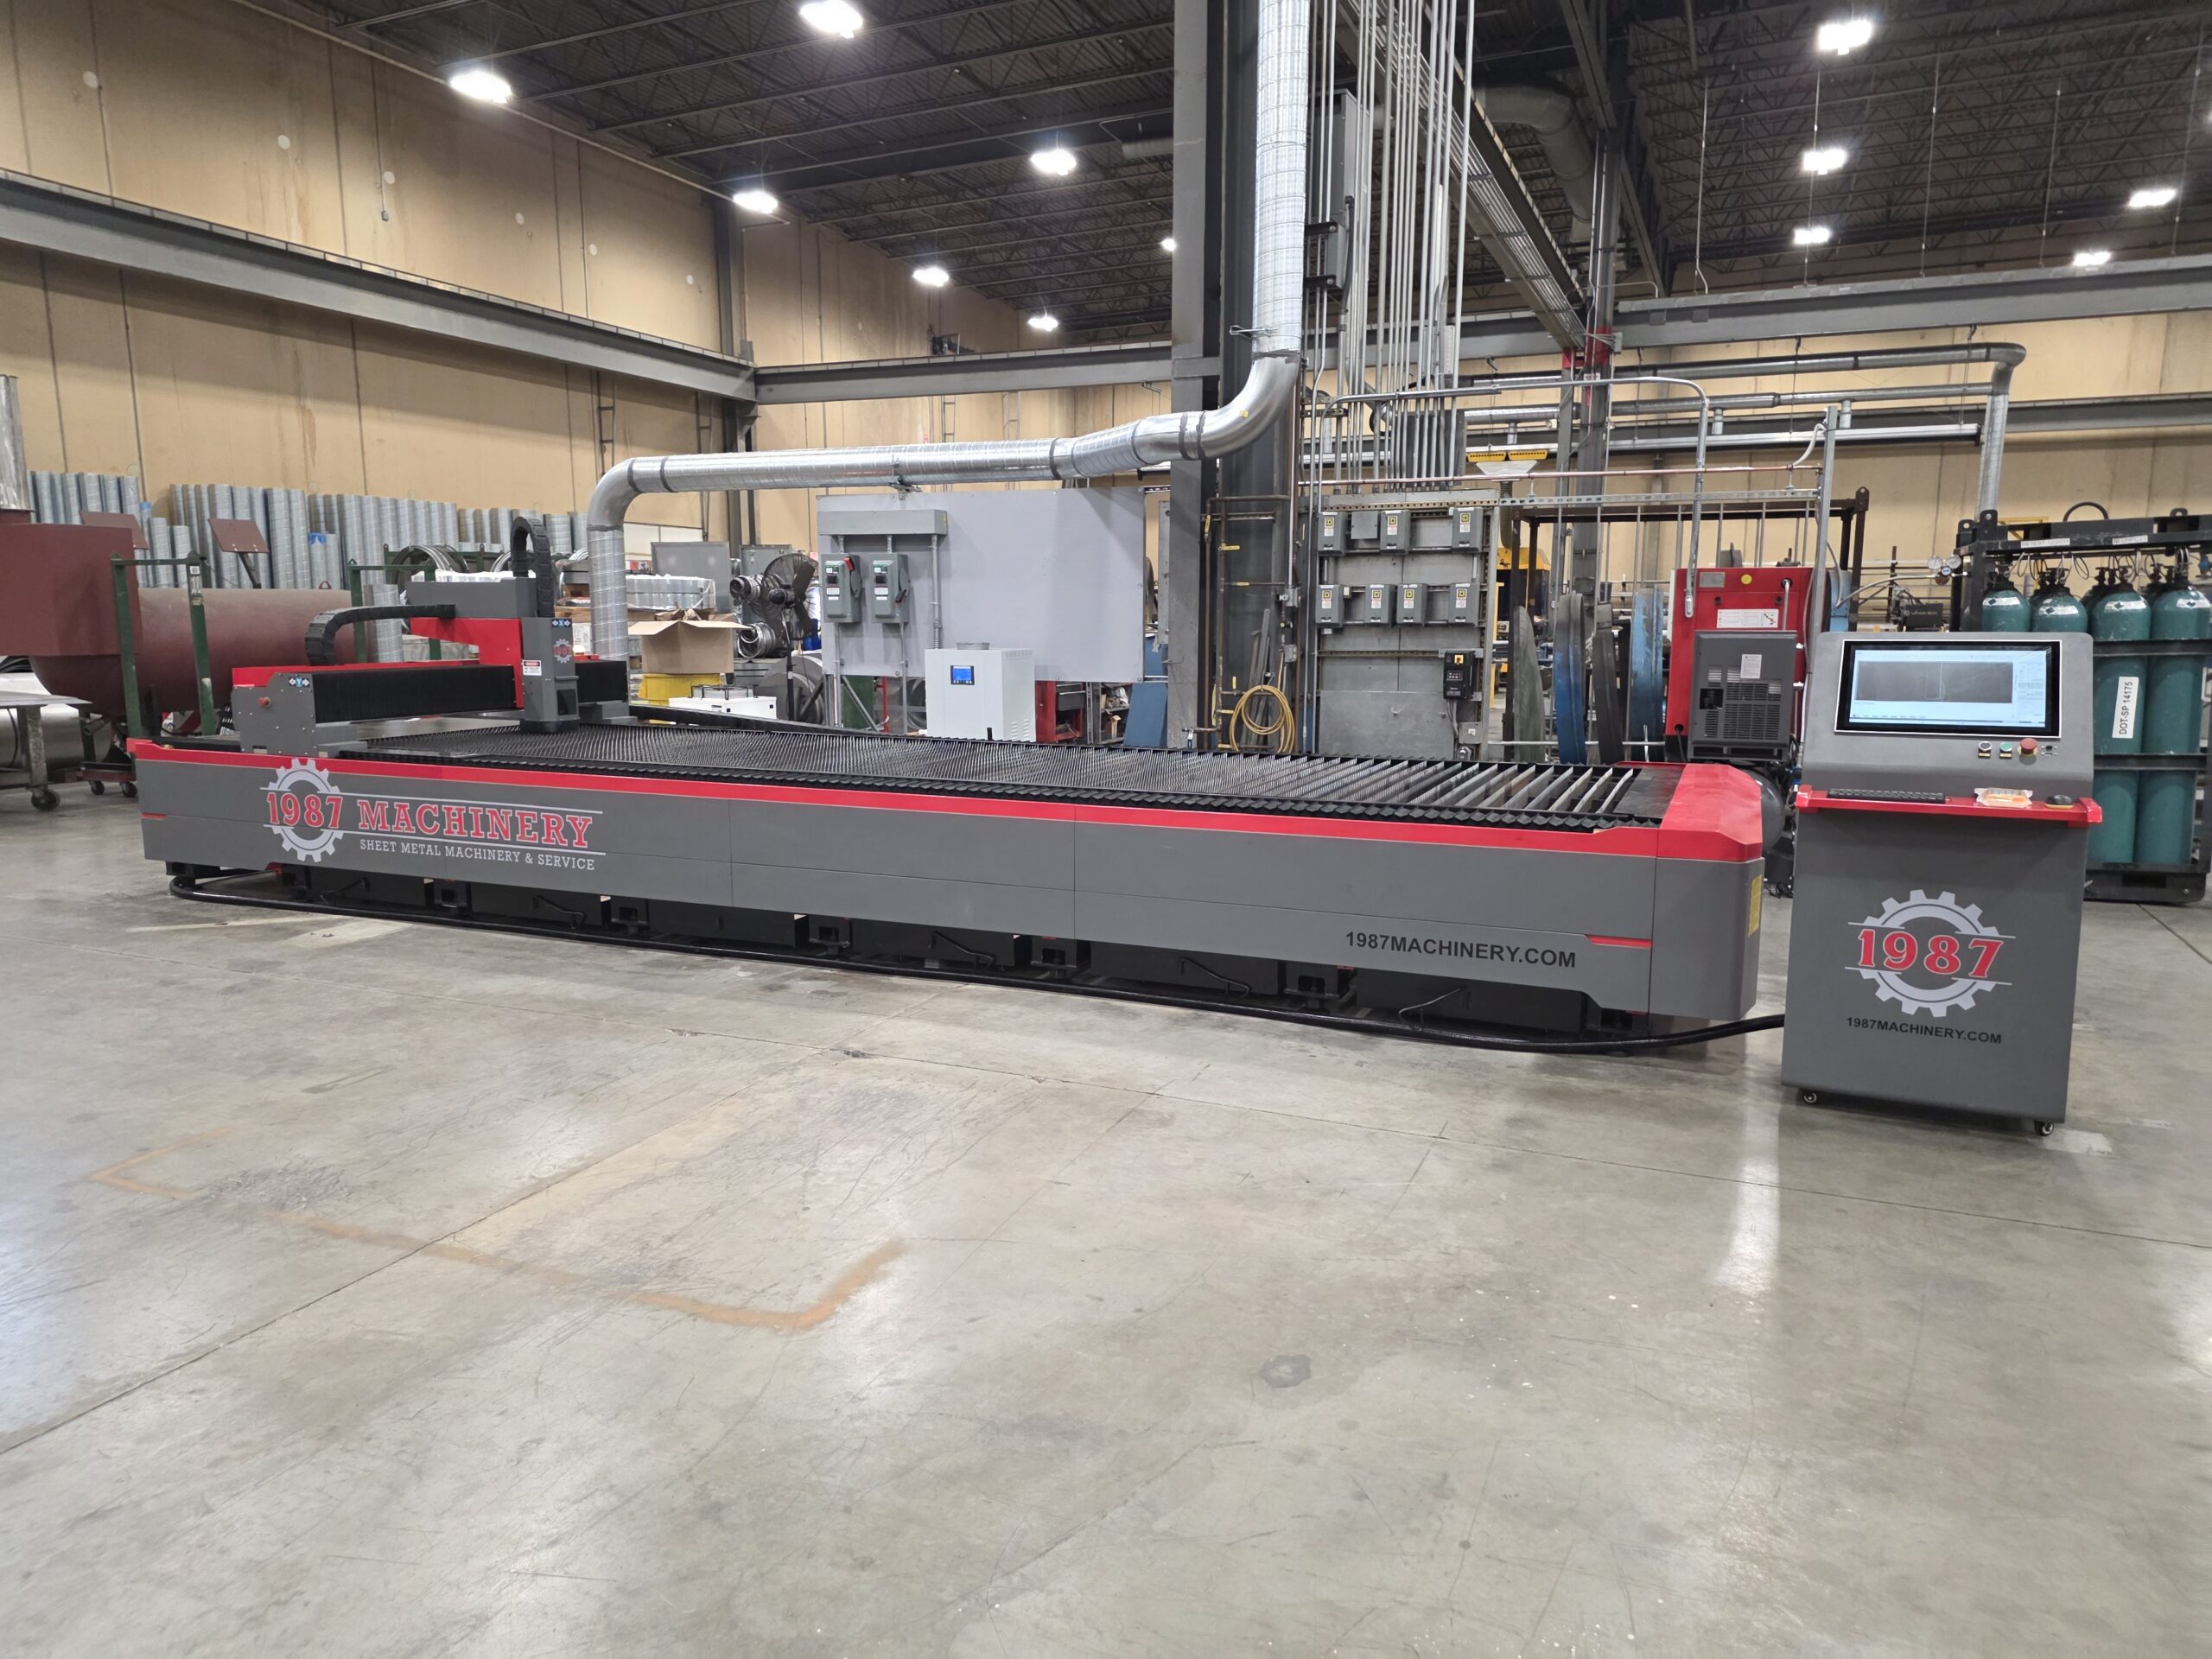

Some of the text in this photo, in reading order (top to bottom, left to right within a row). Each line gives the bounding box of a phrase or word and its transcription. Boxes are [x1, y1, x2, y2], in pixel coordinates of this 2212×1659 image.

[296, 677, 302, 687] Y
[2119, 681, 2133, 734] DOT-SP 14175
[266, 791, 593, 849] 1987 MACHINERY
[359, 838, 595, 871] SHEET METAL MACHINERY & SERVICE
[1345, 931, 1577, 969] 1987MACHINERY.COM
[1858, 928, 2004, 979] 1987
[1847, 1017, 2002, 1045] 1987MACHINERY.COM
